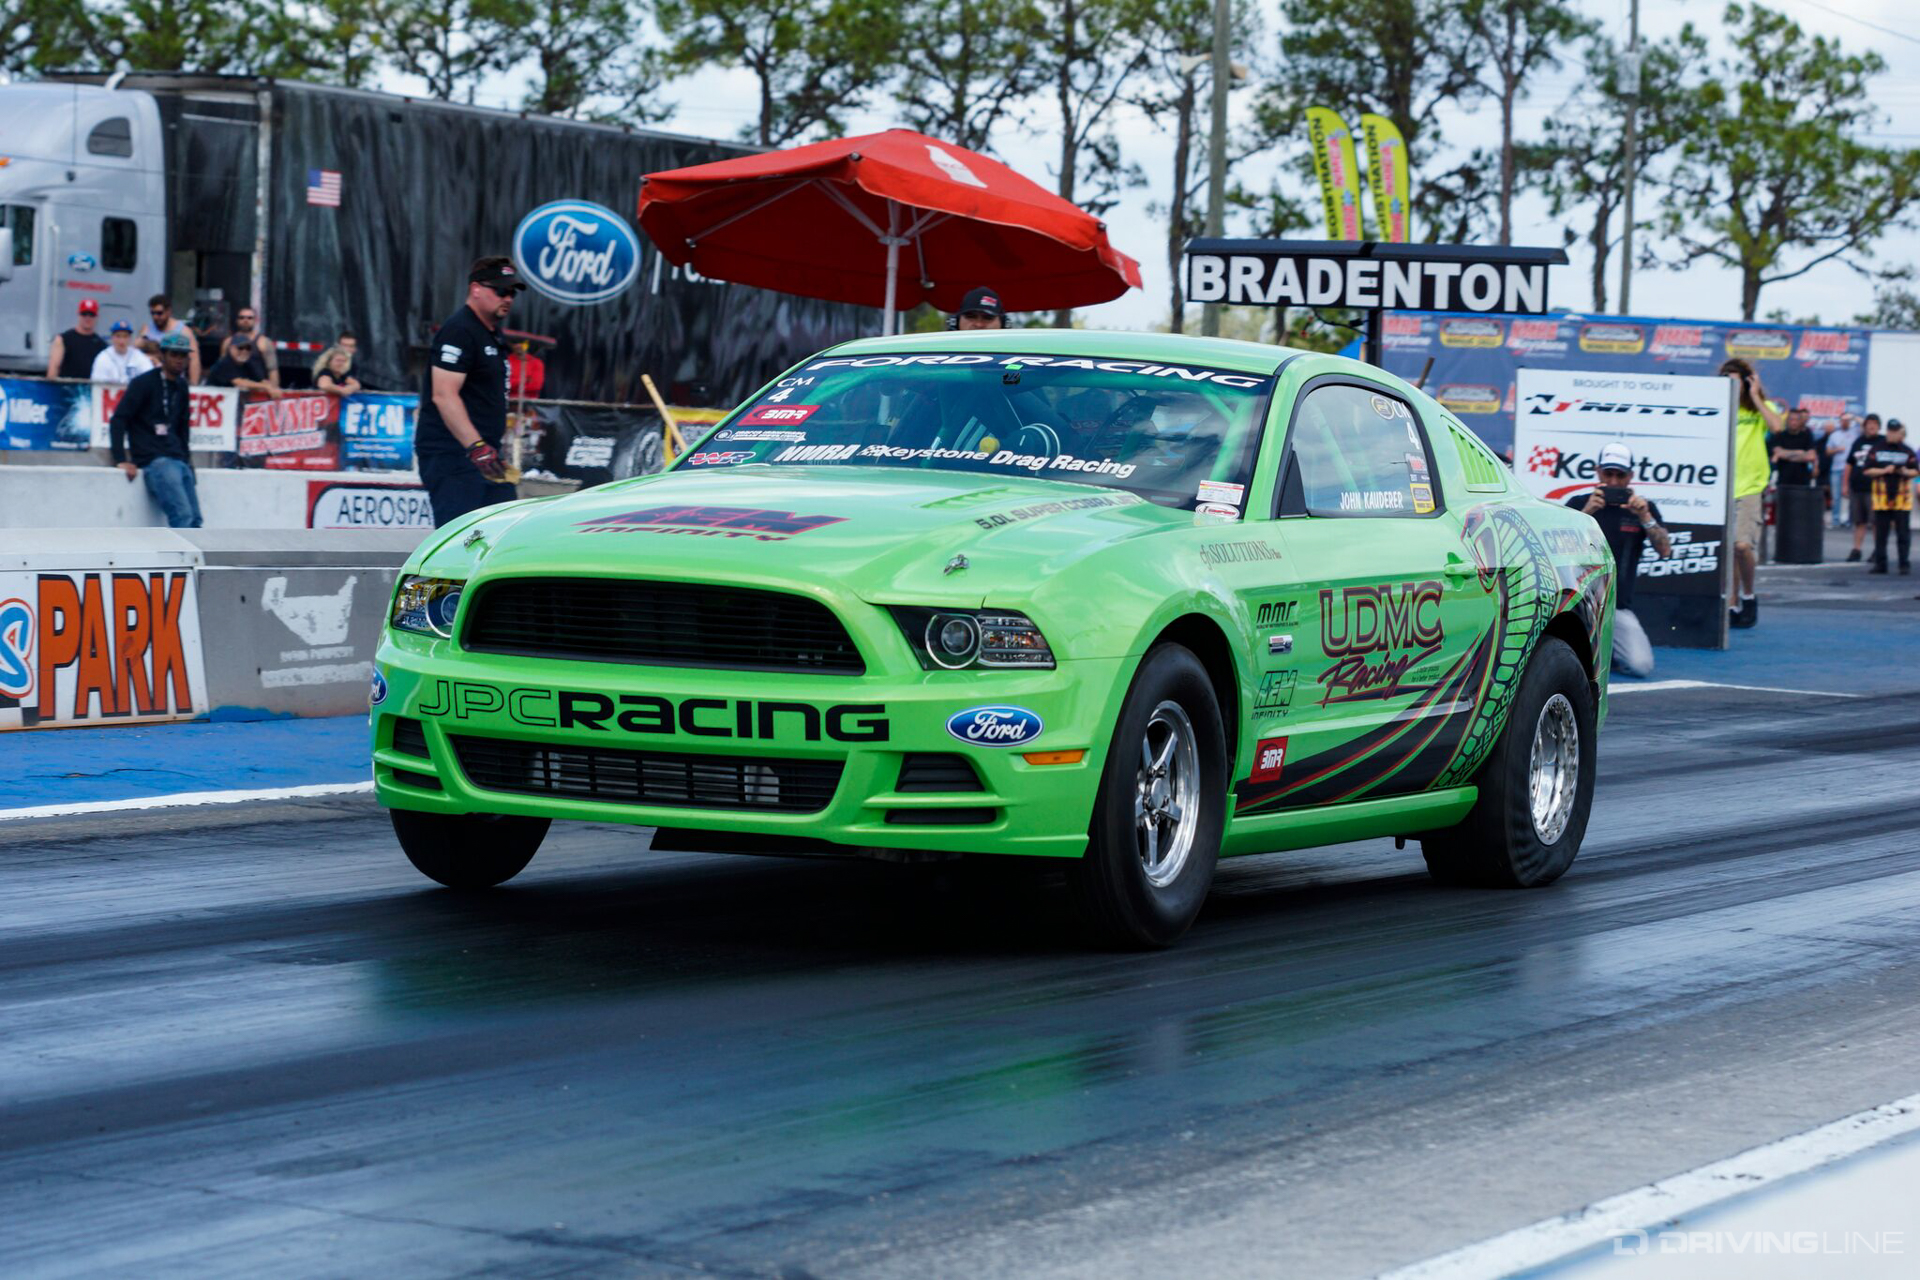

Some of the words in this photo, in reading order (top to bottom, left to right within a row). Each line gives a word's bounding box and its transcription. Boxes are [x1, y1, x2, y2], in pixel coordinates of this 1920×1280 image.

[538, 213, 616, 286] Ford
[1191, 254, 1544, 313] BRADENTON
[777, 377, 815, 388] CM
[805, 354, 993, 371] FORD
[998, 355, 1265, 388] RACING
[1573, 378, 1621, 389] BROUGHT
[1622, 380, 1637, 390] TO
[1640, 380, 1660, 391] YOU
[1662, 382, 1674, 391] BY
[768, 387, 795, 403] 4
[1406, 421, 1420, 450] 4
[774, 444, 861, 461] NMRA
[879, 446, 987, 461] Keystone
[989, 450, 1050, 470] Drag
[1049, 455, 1137, 479] Racing
[1554, 452, 1718, 485] Ketone
[974, 512, 1016, 530] 5.0L
[1011, 503, 1062, 521] SUPER
[1063, 496, 1115, 512] COBRA
[1340, 491, 1362, 510] JOHN
[1363, 491, 1404, 509] KAUDERER
[577, 526, 792, 541] INFINITY
[1636, 556, 1718, 577] FORDS
[1319, 581, 1443, 658] UDMC
[37, 572, 193, 721] PARK
[1317, 651, 1441, 709] Racing
[966, 711, 1027, 740] Ford
[1251, 709, 1289, 720] INFINITY
